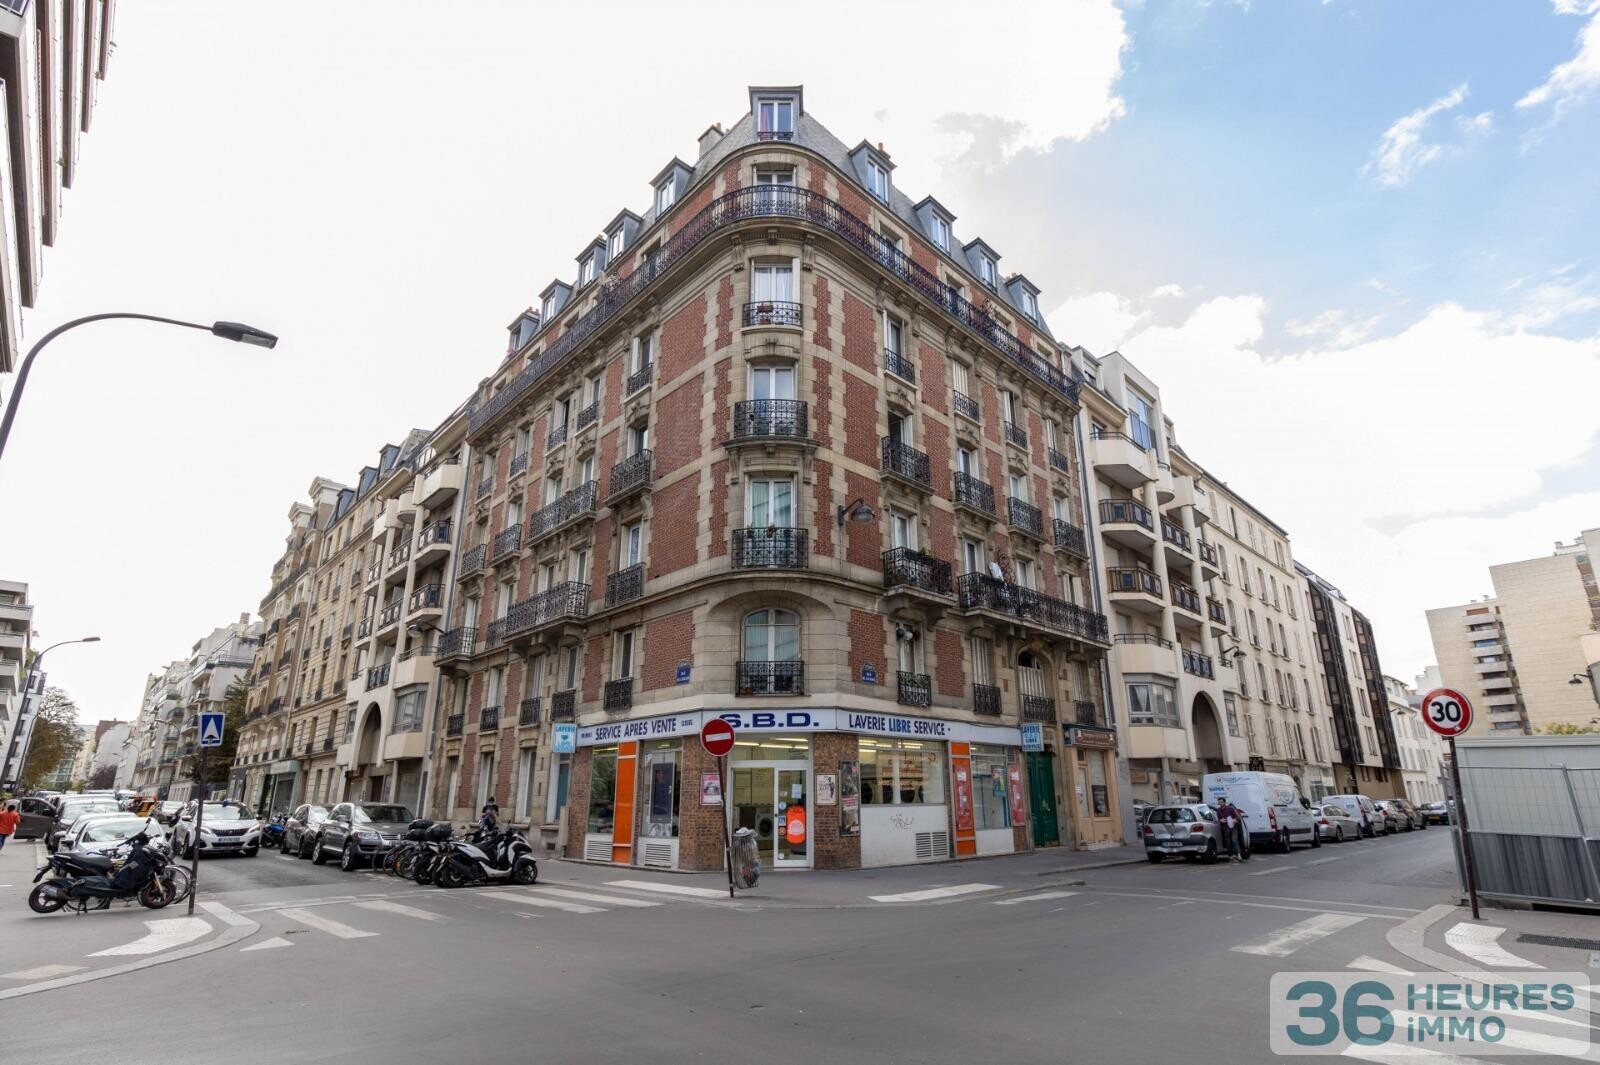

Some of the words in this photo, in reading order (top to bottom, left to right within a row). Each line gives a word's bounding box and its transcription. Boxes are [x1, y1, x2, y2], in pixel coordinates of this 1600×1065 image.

[719, 713, 819, 728] S.B.D.
[1431, 701, 1461, 722] 30
[595, 726, 622, 741] SERVICE
[624, 720, 648, 737] APRES
[651, 717, 677, 734] VENTE
[849, 714, 886, 731] LAVERIE
[889, 718, 911, 733] LIBRE
[914, 721, 945, 736] SERVICE
